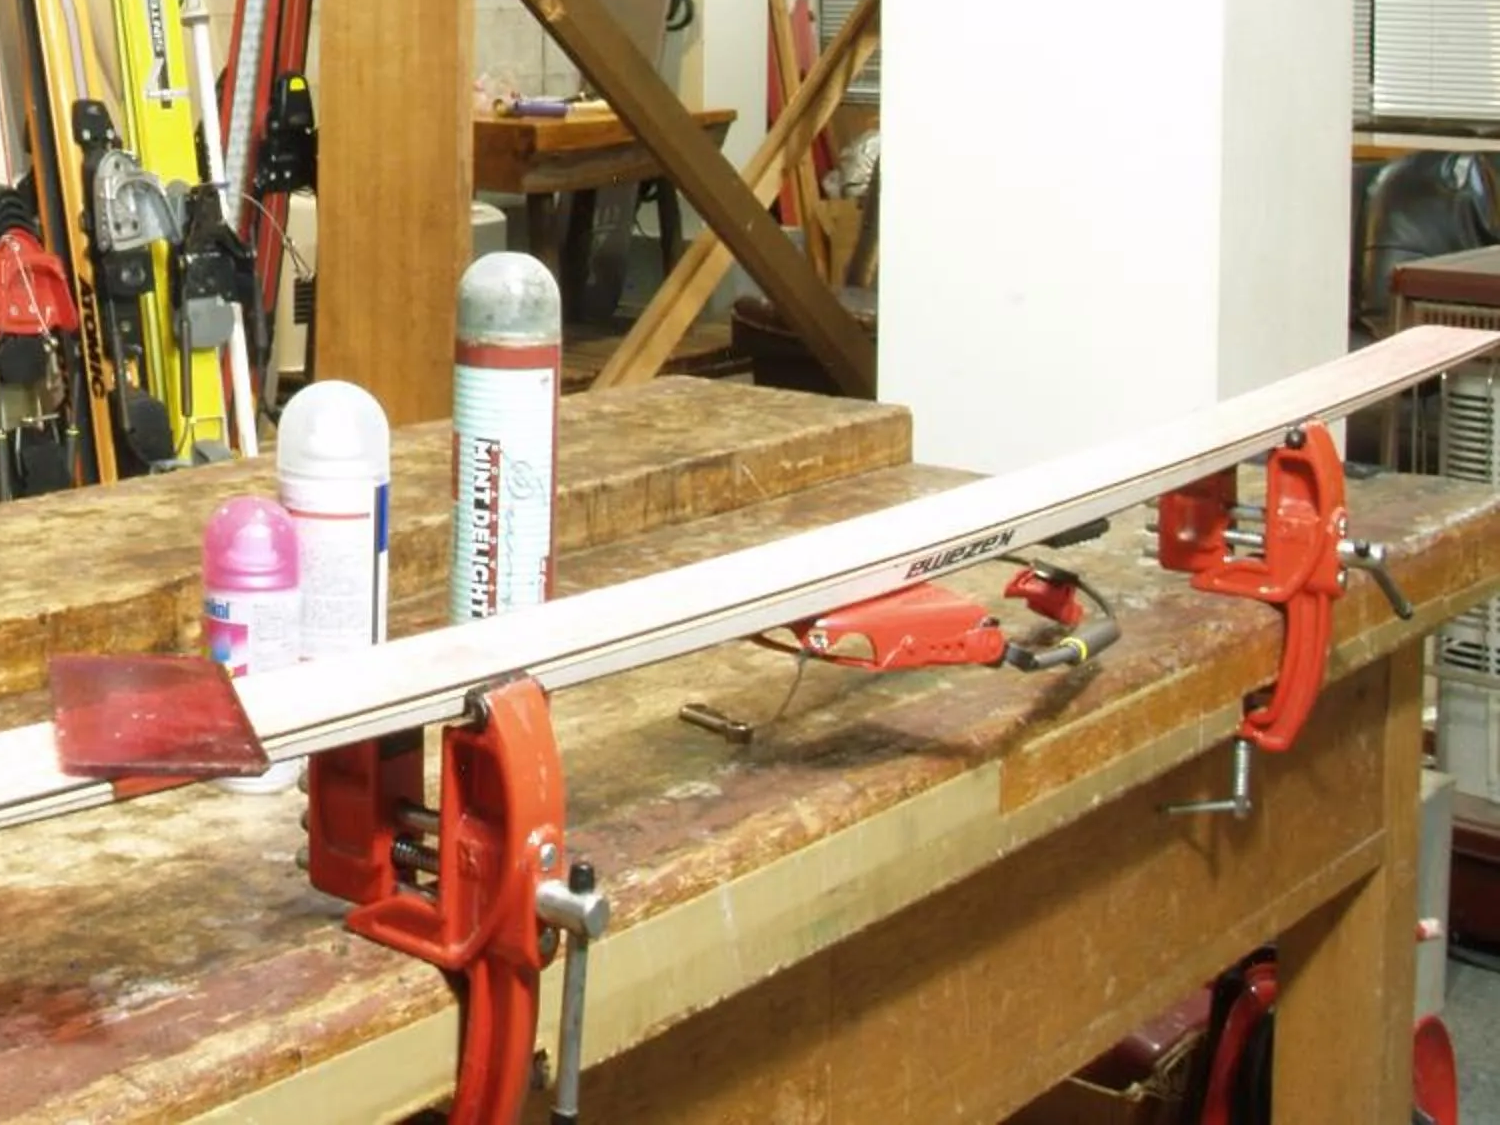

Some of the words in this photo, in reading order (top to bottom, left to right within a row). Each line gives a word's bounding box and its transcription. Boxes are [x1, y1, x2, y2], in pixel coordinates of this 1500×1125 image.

[79, 274, 106, 400] ATOMIC
[473, 439, 492, 505] MINT
[471, 507, 492, 619] DELIGHT
